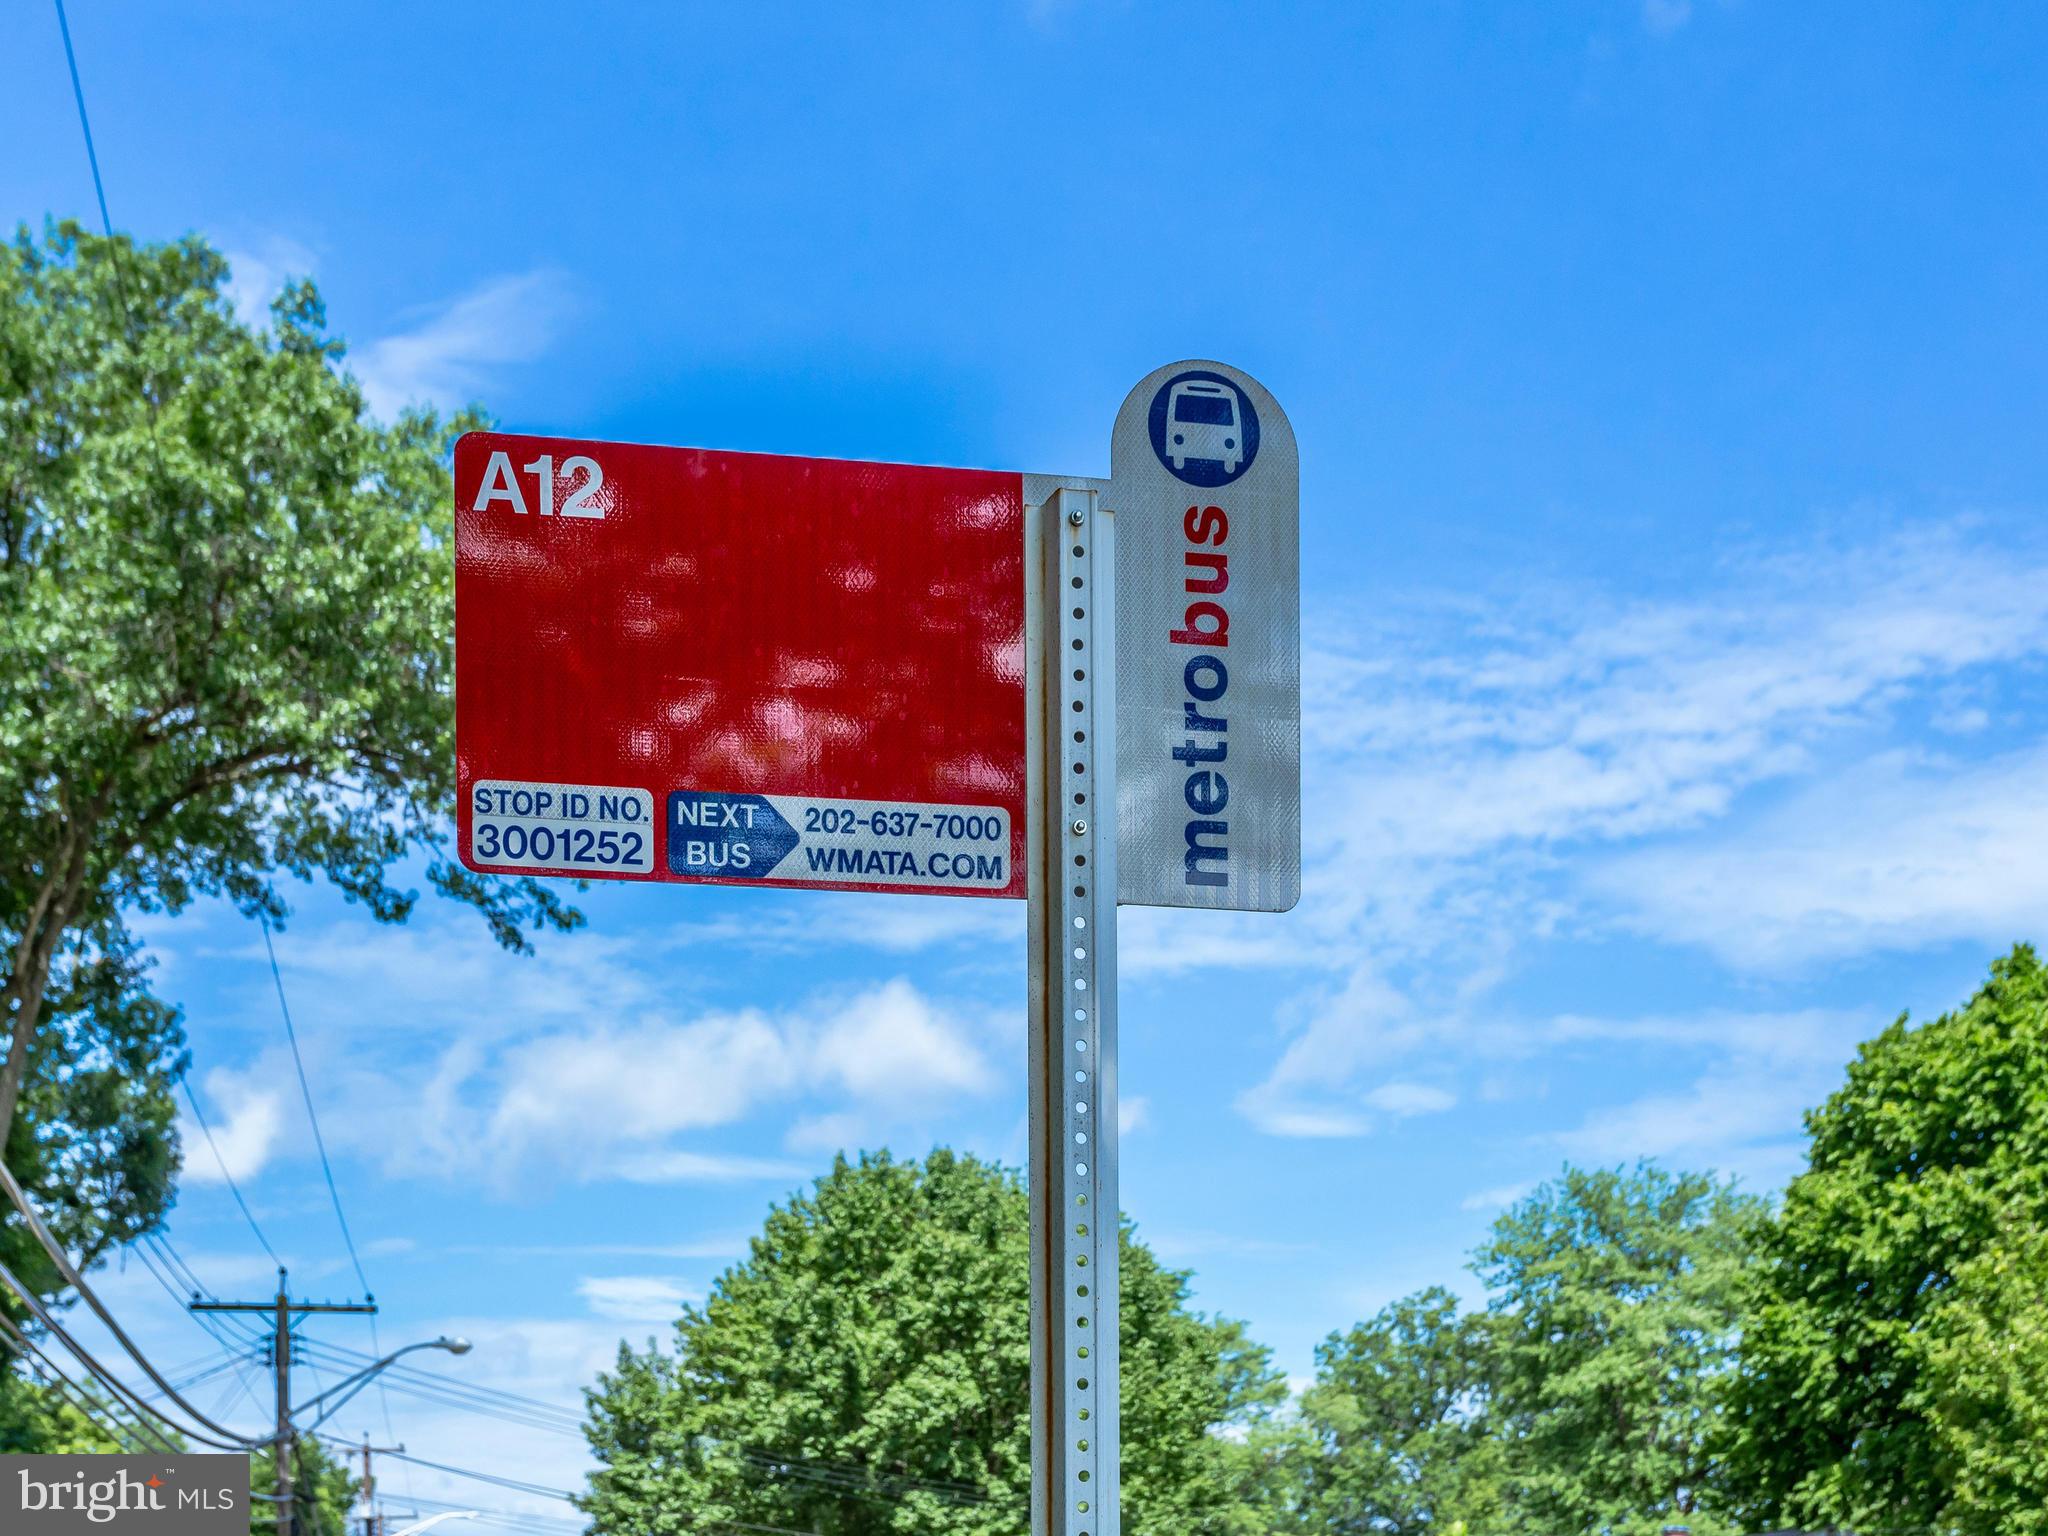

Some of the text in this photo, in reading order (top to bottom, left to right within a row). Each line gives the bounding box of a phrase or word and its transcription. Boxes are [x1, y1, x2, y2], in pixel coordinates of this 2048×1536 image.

[473, 451, 605, 519] A12
[1170, 506, 1230, 887] metrobus
[475, 788, 649, 822] STOP ID NO.
[677, 801, 759, 829] NEXT
[805, 807, 1001, 841] 202-637-7000
[477, 824, 643, 865] 3001252
[687, 840, 750, 869] BUS
[805, 847, 1002, 880] WMATA.COM
